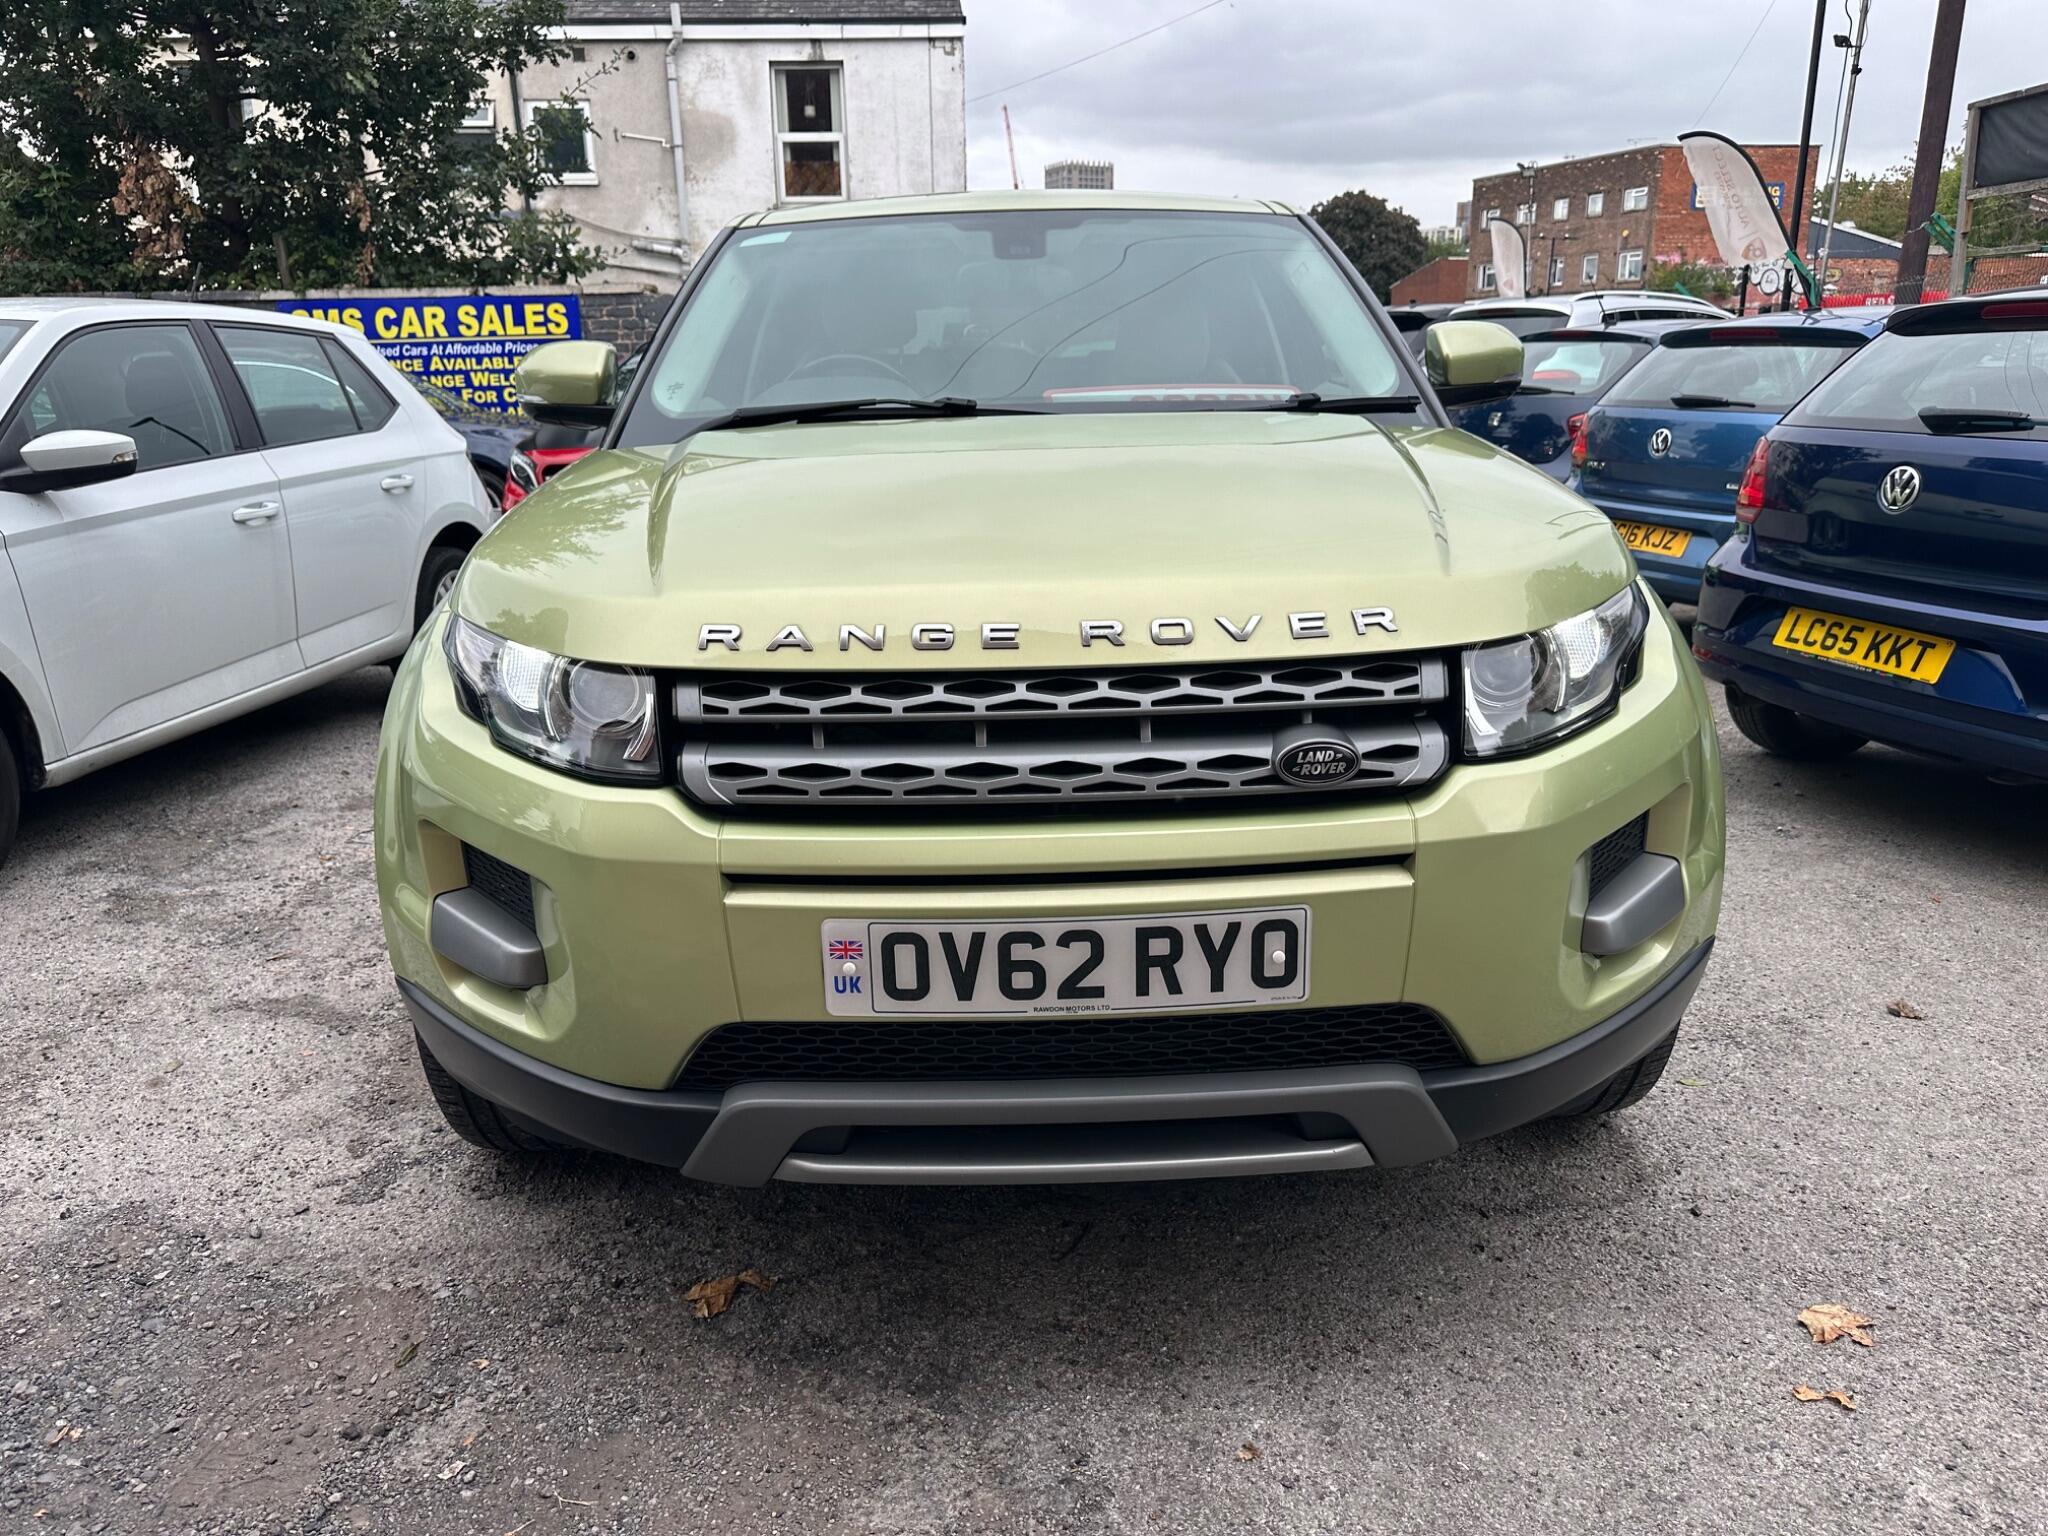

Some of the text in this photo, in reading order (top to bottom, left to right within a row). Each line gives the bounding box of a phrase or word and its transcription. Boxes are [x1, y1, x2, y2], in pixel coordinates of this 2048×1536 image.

[374, 305, 446, 339] CAR
[457, 302, 569, 336] SALES
[402, 344, 428, 357] Cars
[430, 343, 444, 356] At
[445, 341, 502, 355] Affordable
[461, 388, 498, 404] FOR
[1640, 527, 1680, 551] KJZ
[698, 607, 1399, 651] RANGE ROVER
[1784, 614, 1865, 656] LC65
[1862, 630, 1937, 673] KKT
[1296, 750, 1335, 763] LAND
[1300, 762, 1347, 776] ROVER
[880, 918, 1299, 1002] OV62 RYO
[833, 975, 862, 994] UK
